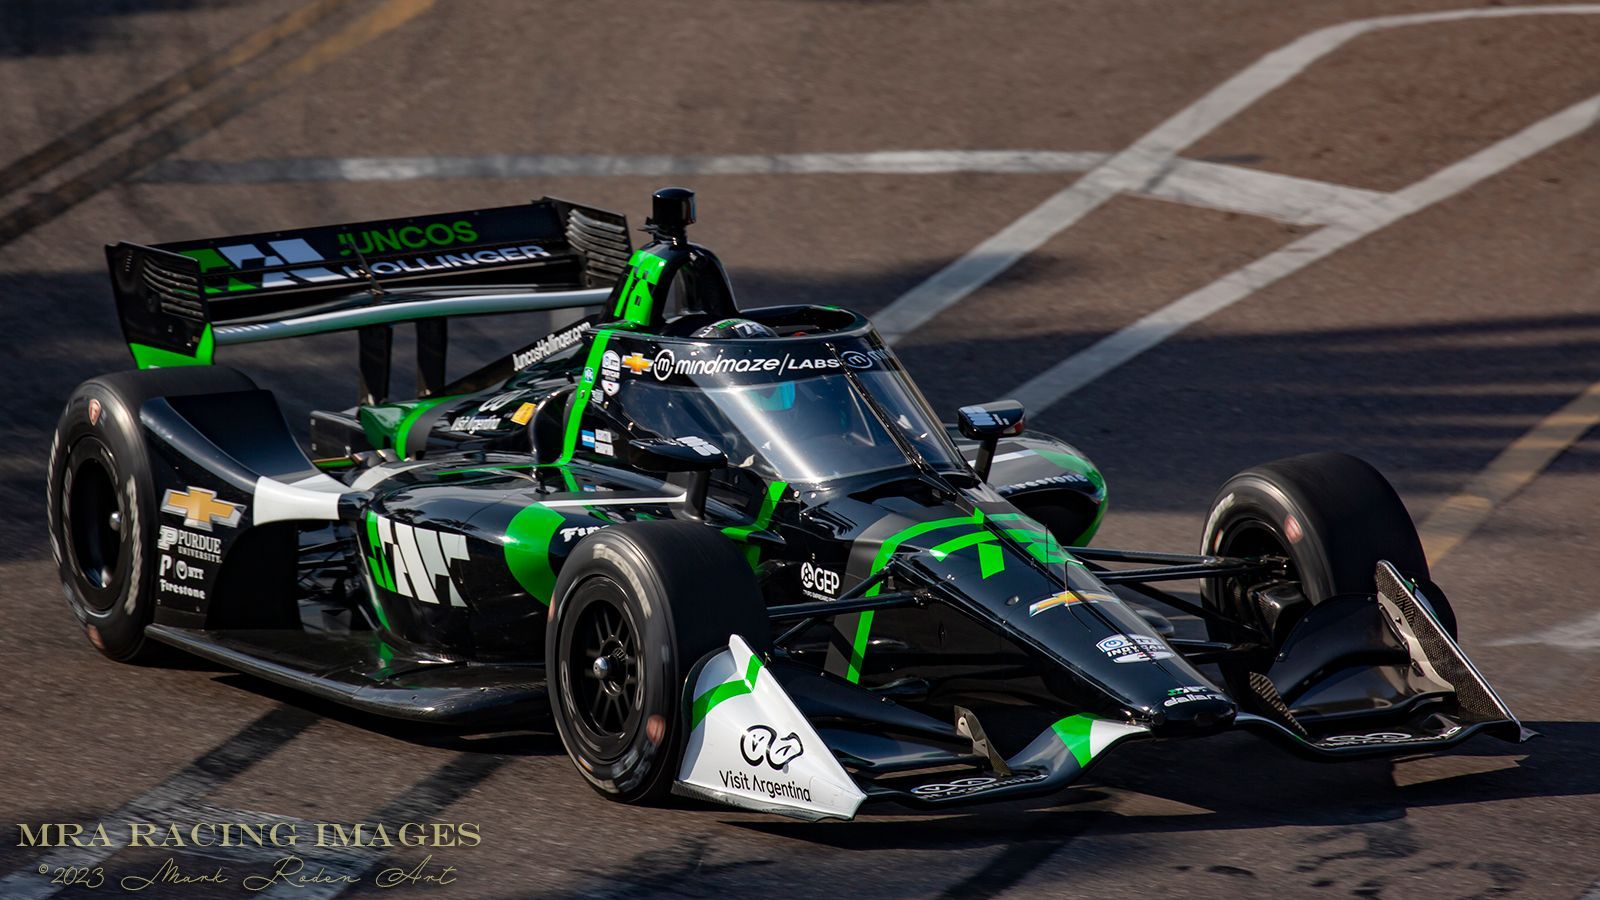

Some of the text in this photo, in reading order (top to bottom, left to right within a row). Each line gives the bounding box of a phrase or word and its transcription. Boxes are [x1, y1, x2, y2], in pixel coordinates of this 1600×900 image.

[337, 220, 479, 256] JUNCOS
[342, 245, 551, 279] HOLLINGER
[178, 529, 222, 555] PURDUE
[160, 578, 206, 600] Firestone
[815, 567, 840, 595] GEP
[1163, 693, 1228, 707] dallara
[719, 770, 812, 803] Visit Argentina
